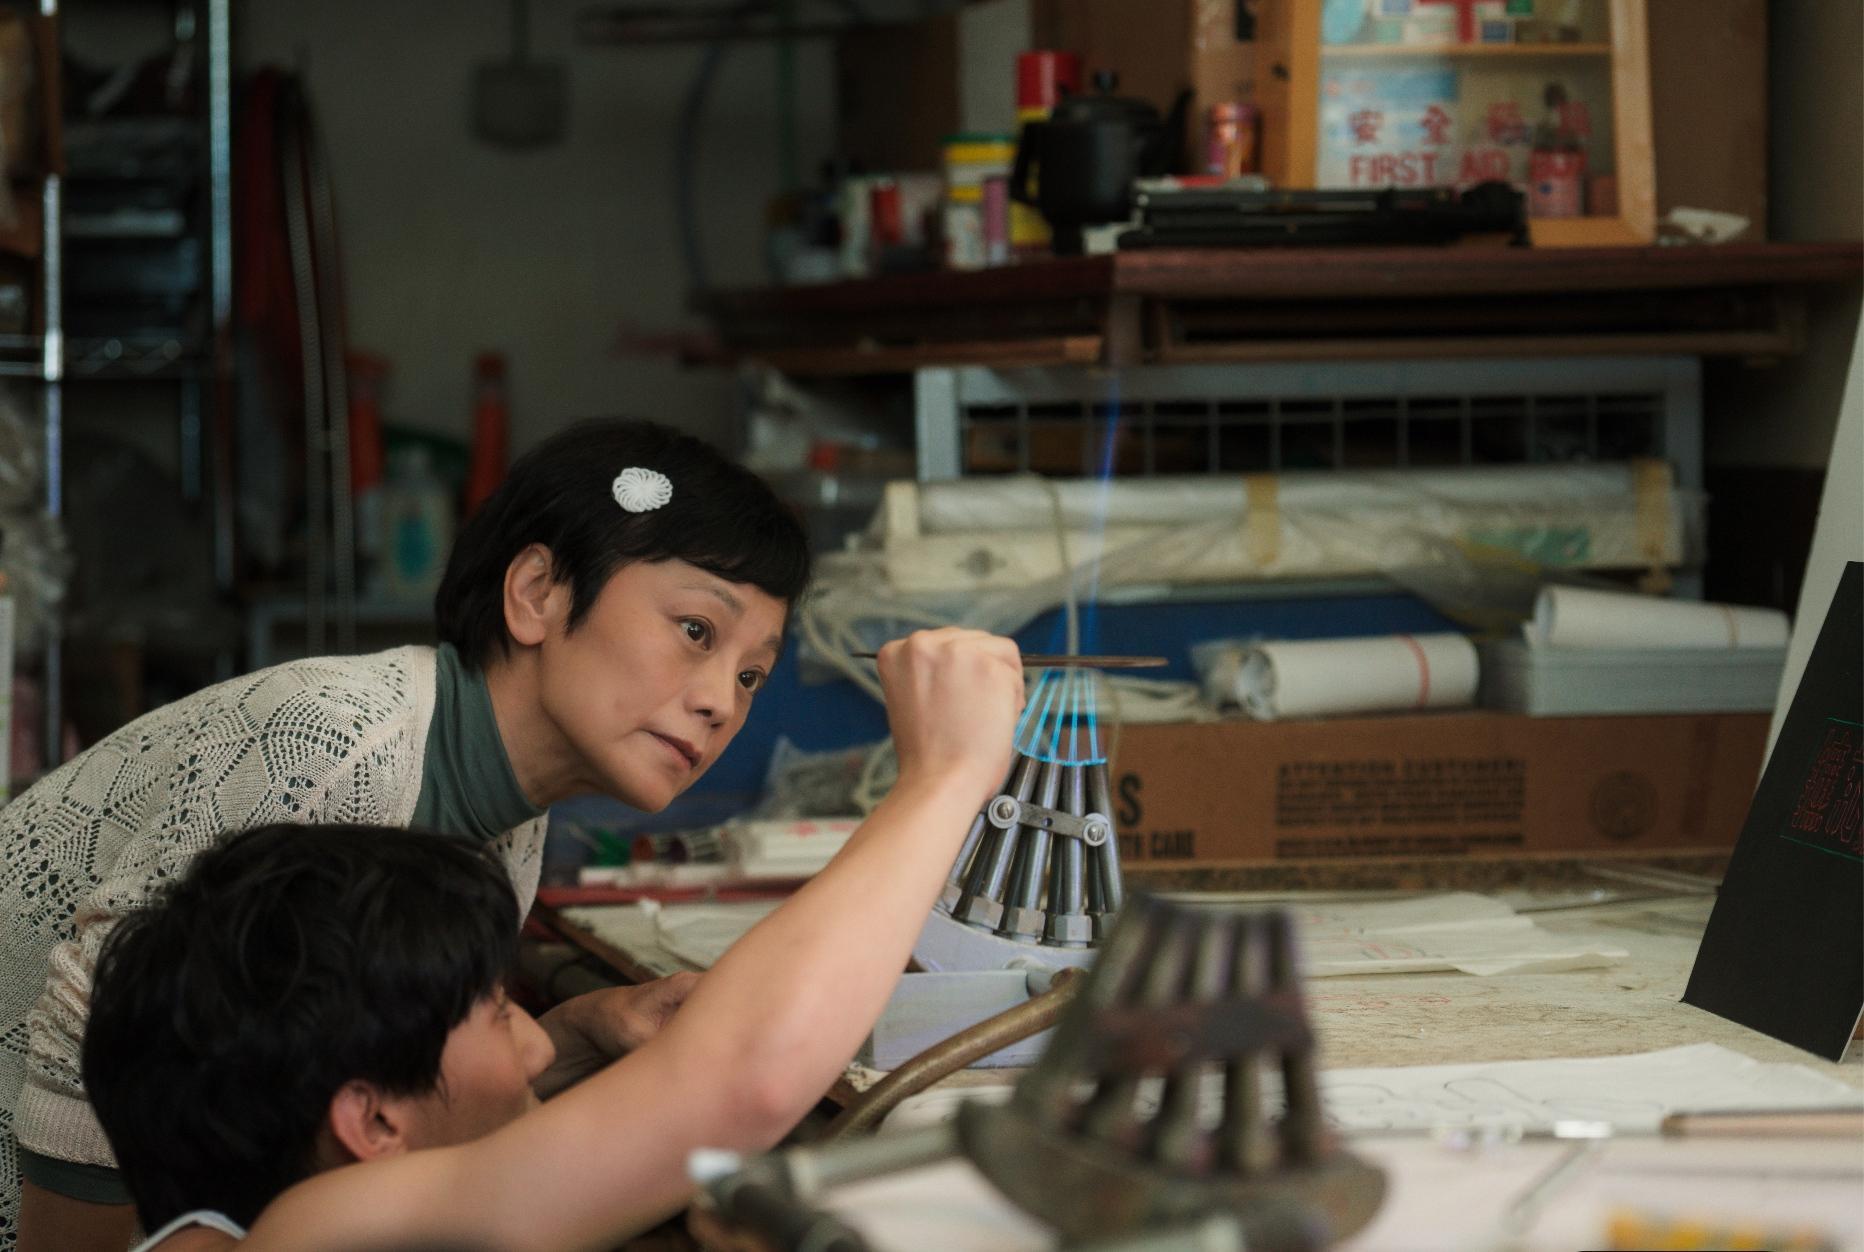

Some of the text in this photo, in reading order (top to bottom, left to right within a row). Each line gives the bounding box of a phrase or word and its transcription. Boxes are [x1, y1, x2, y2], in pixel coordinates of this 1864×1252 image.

[1350, 152, 1438, 184] FIRST
[1460, 150, 1510, 182] AID
[1277, 762, 1398, 779] ATTENTION
[1151, 830, 1196, 859] CARE
